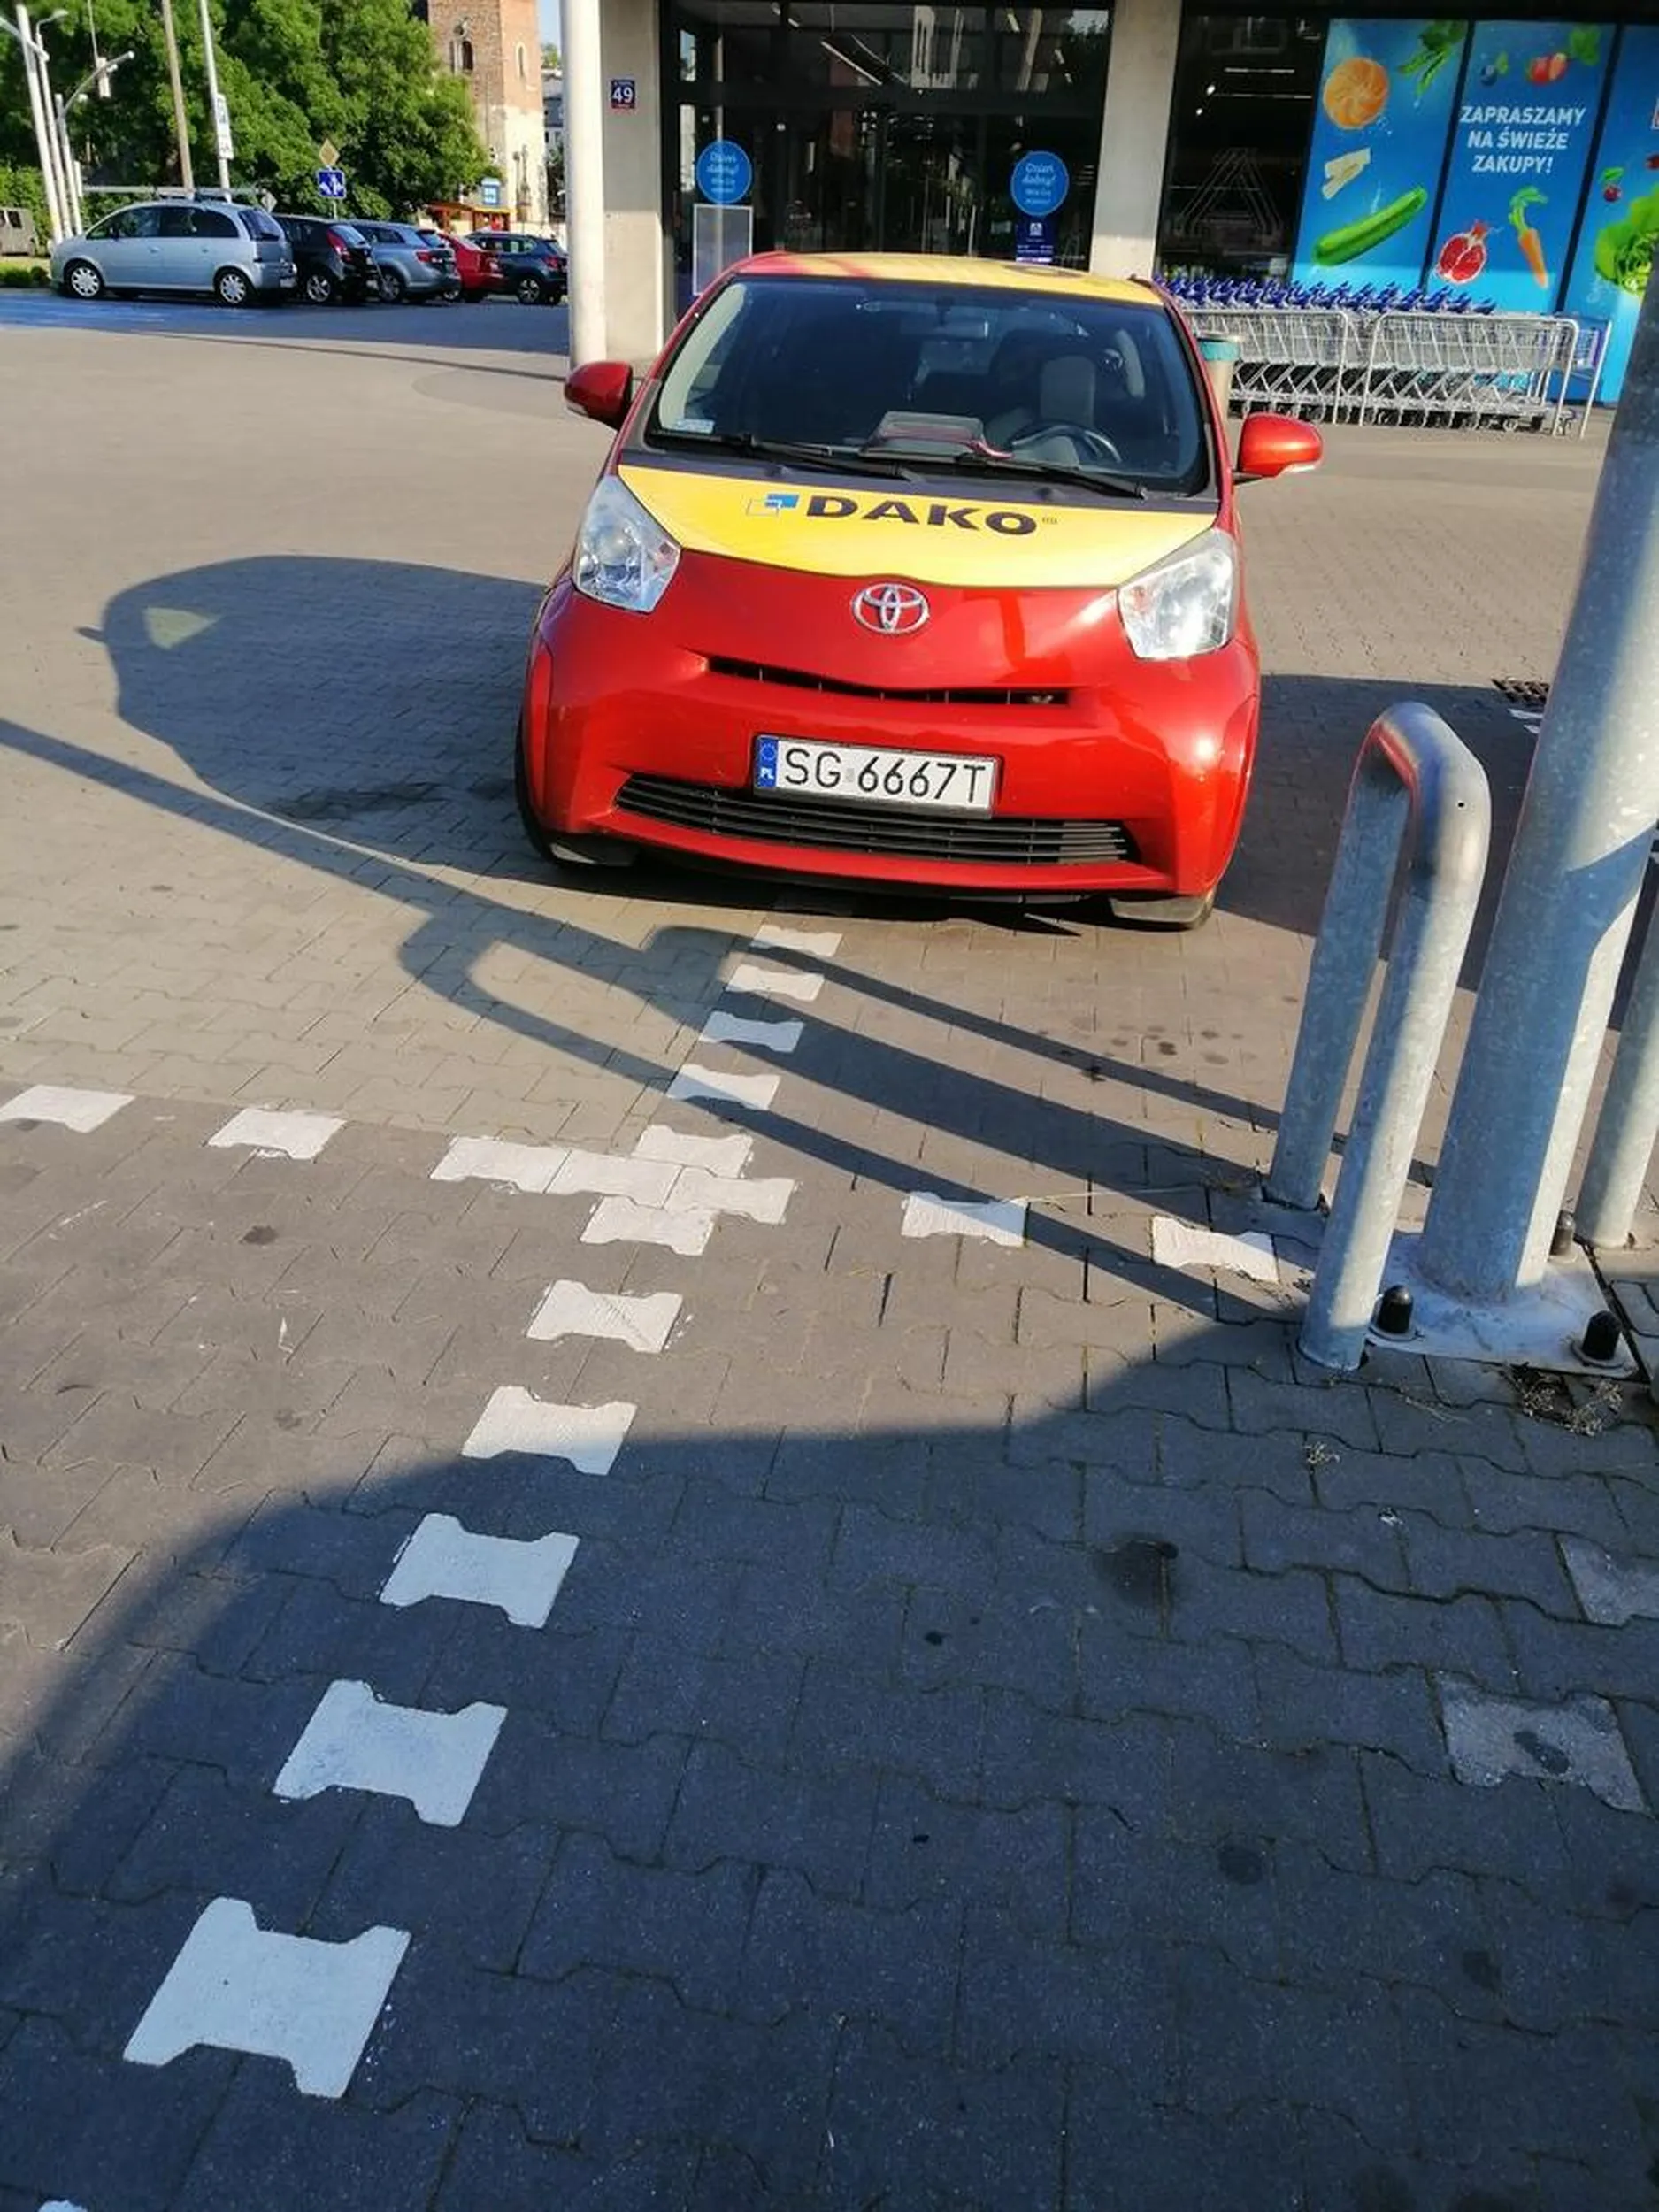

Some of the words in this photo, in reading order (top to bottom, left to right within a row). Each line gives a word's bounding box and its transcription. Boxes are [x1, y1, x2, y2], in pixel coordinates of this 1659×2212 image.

[612, 86, 634, 104] 49
[1460, 105, 1586, 126] ZAPRASZAMY
[1467, 130, 1493, 149] NA
[1496, 126, 1571, 150] ŚWIEŻE
[1471, 154, 1554, 173] ZAKUPY!
[806, 495, 1038, 536] DAKO
[784, 748, 842, 788] SG
[856, 755, 987, 803] 6667T
